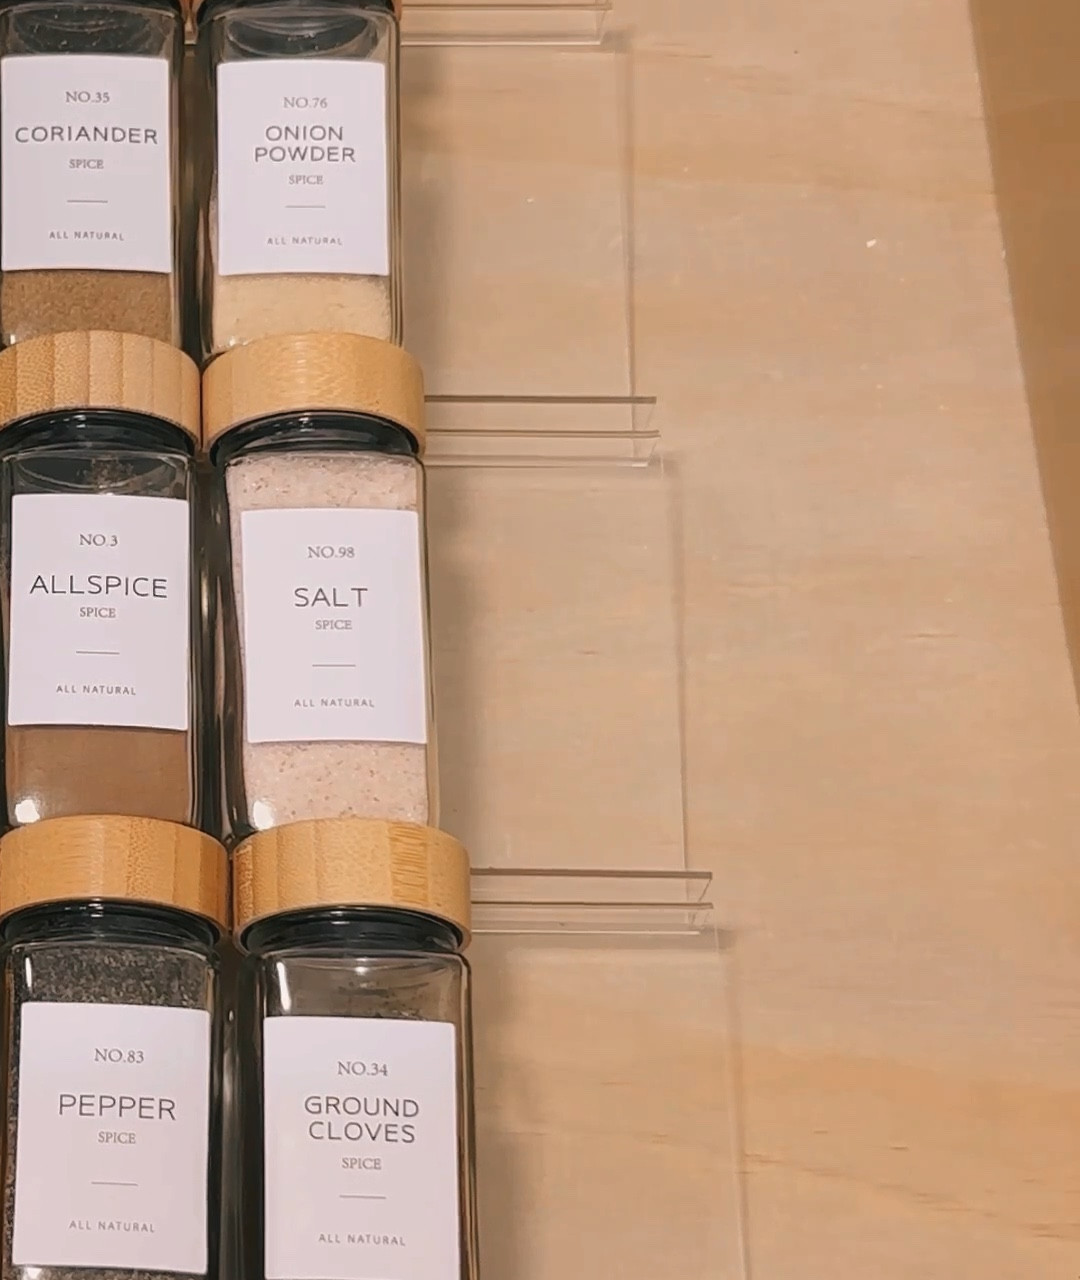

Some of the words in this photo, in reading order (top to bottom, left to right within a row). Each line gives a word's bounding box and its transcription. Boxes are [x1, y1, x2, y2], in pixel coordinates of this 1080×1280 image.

[66, 91, 110, 103] NO.35
[284, 97, 327, 108] NO.76
[15, 126, 157, 144] CORIANDER
[266, 125, 343, 141] ONION
[255, 146, 355, 162] POWDER
[69, 159, 104, 169] SPICE
[289, 175, 323, 184] SPICE
[50, 232, 69, 240] ALL
[74, 231, 124, 242] NATURAL
[268, 237, 287, 246] ALL
[292, 237, 343, 246] NATURAL
[80, 534, 117, 546] NO.3
[308, 546, 355, 558] NO.98
[30, 575, 167, 598] ALLSPICE
[295, 588, 368, 607] SALT
[80, 607, 115, 618] SPICE
[316, 620, 352, 630] SPICE
[56, 685, 77, 694] ALL
[83, 686, 137, 696] NATURAL
[294, 699, 315, 708] ALL
[321, 698, 375, 708] NATURAL
[95, 1048, 144, 1063] NO.83
[338, 1062, 387, 1076] NO.34
[60, 1094, 175, 1120] PEPPER
[305, 1096, 419, 1117] GROUND
[98, 1131, 136, 1144] SPICE
[309, 1121, 414, 1143] CLOVES
[342, 1158, 381, 1170] SPICE
[69, 1220, 92, 1231] ALL
[98, 1222, 155, 1234] NATURAL
[319, 1234, 341, 1244] ALL
[348, 1234, 406, 1247] NATURAL
